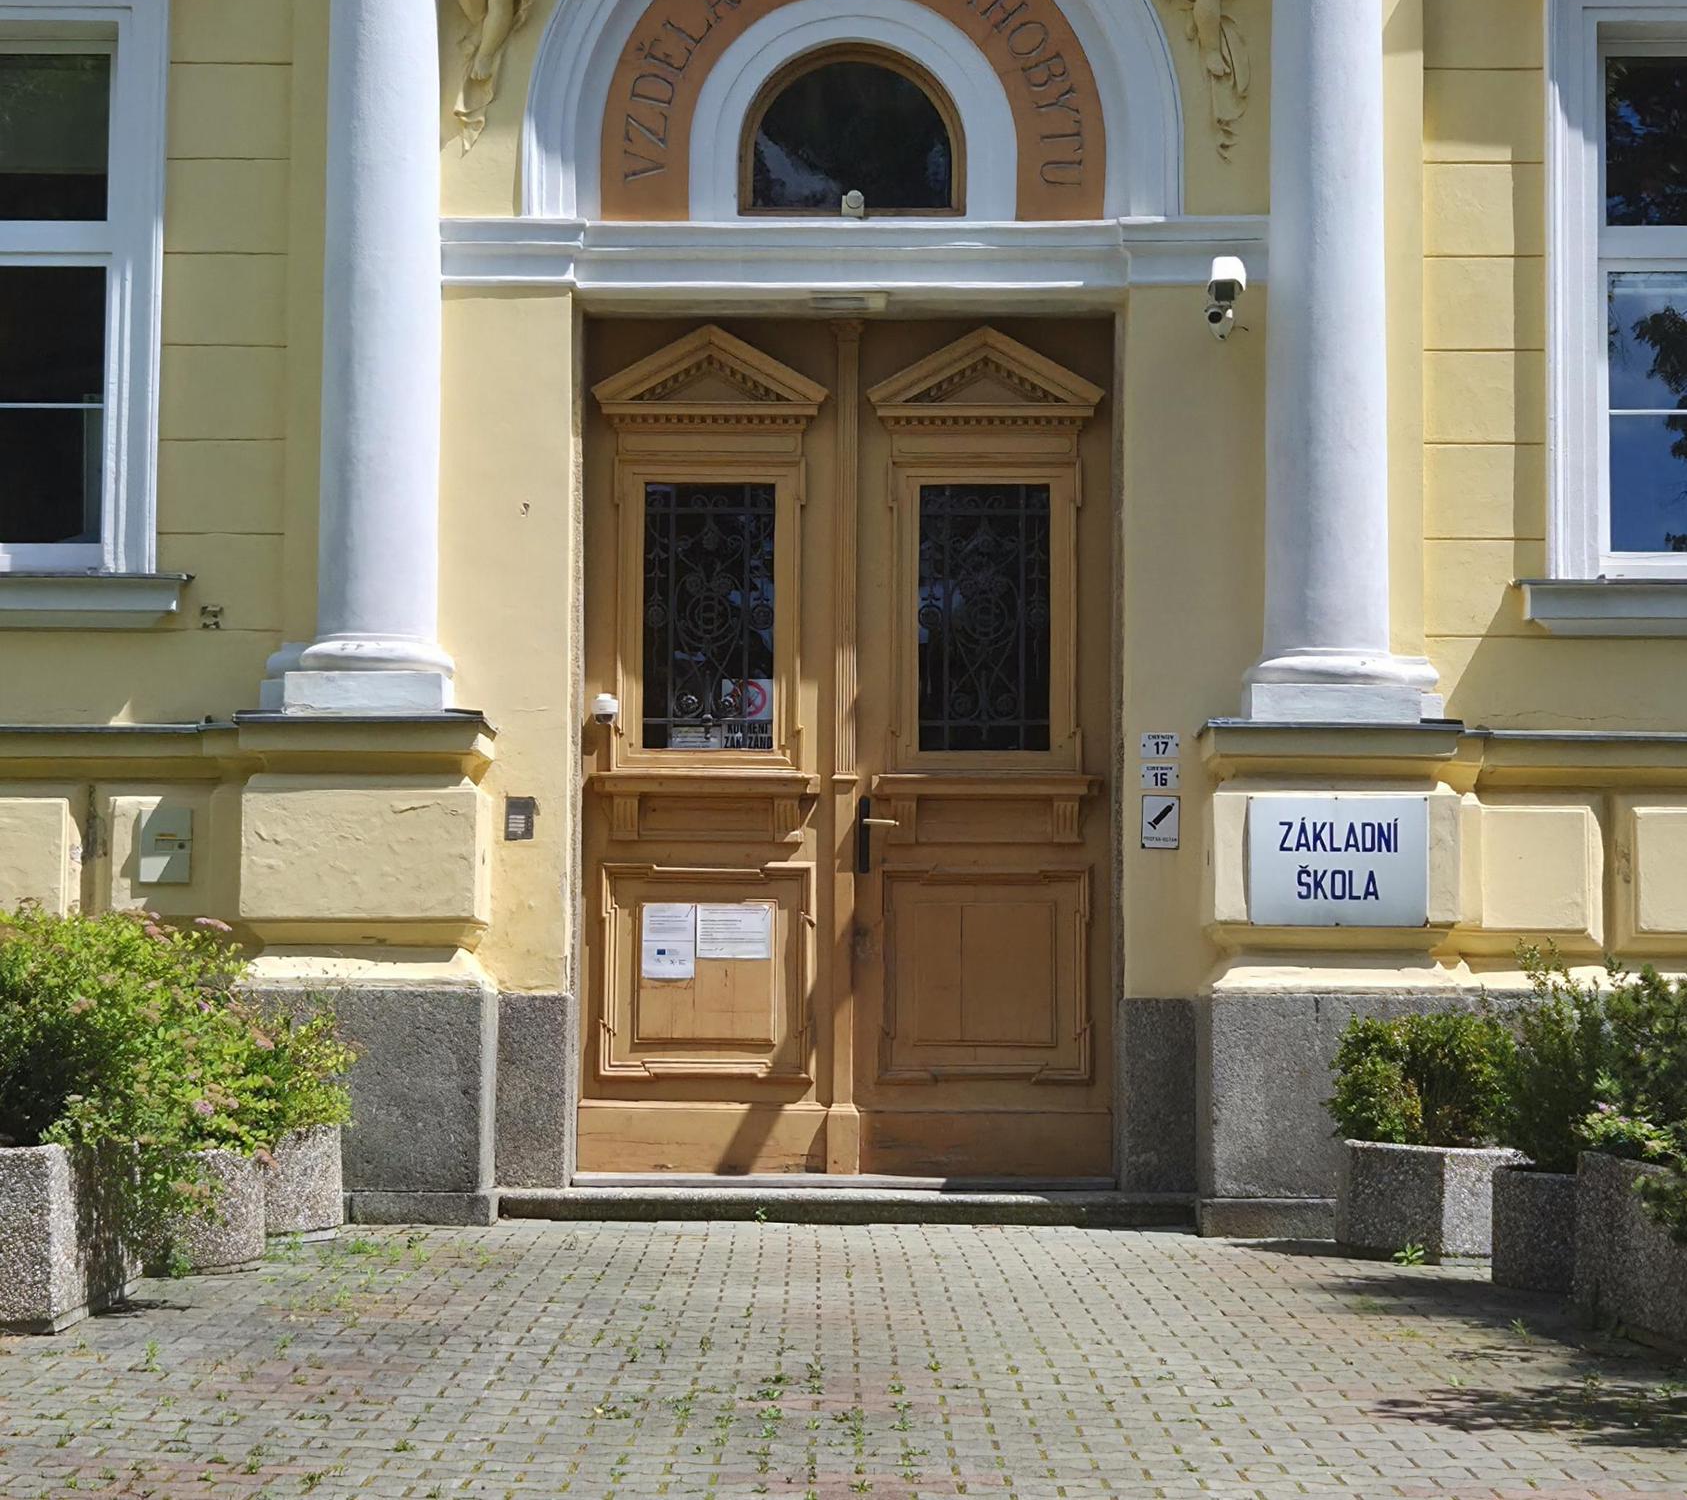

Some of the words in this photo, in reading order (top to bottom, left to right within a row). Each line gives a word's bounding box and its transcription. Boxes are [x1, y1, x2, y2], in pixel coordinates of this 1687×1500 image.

[1153, 741, 1169, 755] 17
[1152, 772, 1168, 787] 16
[1278, 817, 1399, 853] ZÁKLADNÍ
[1296, 865, 1380, 901] ŠKOLA
